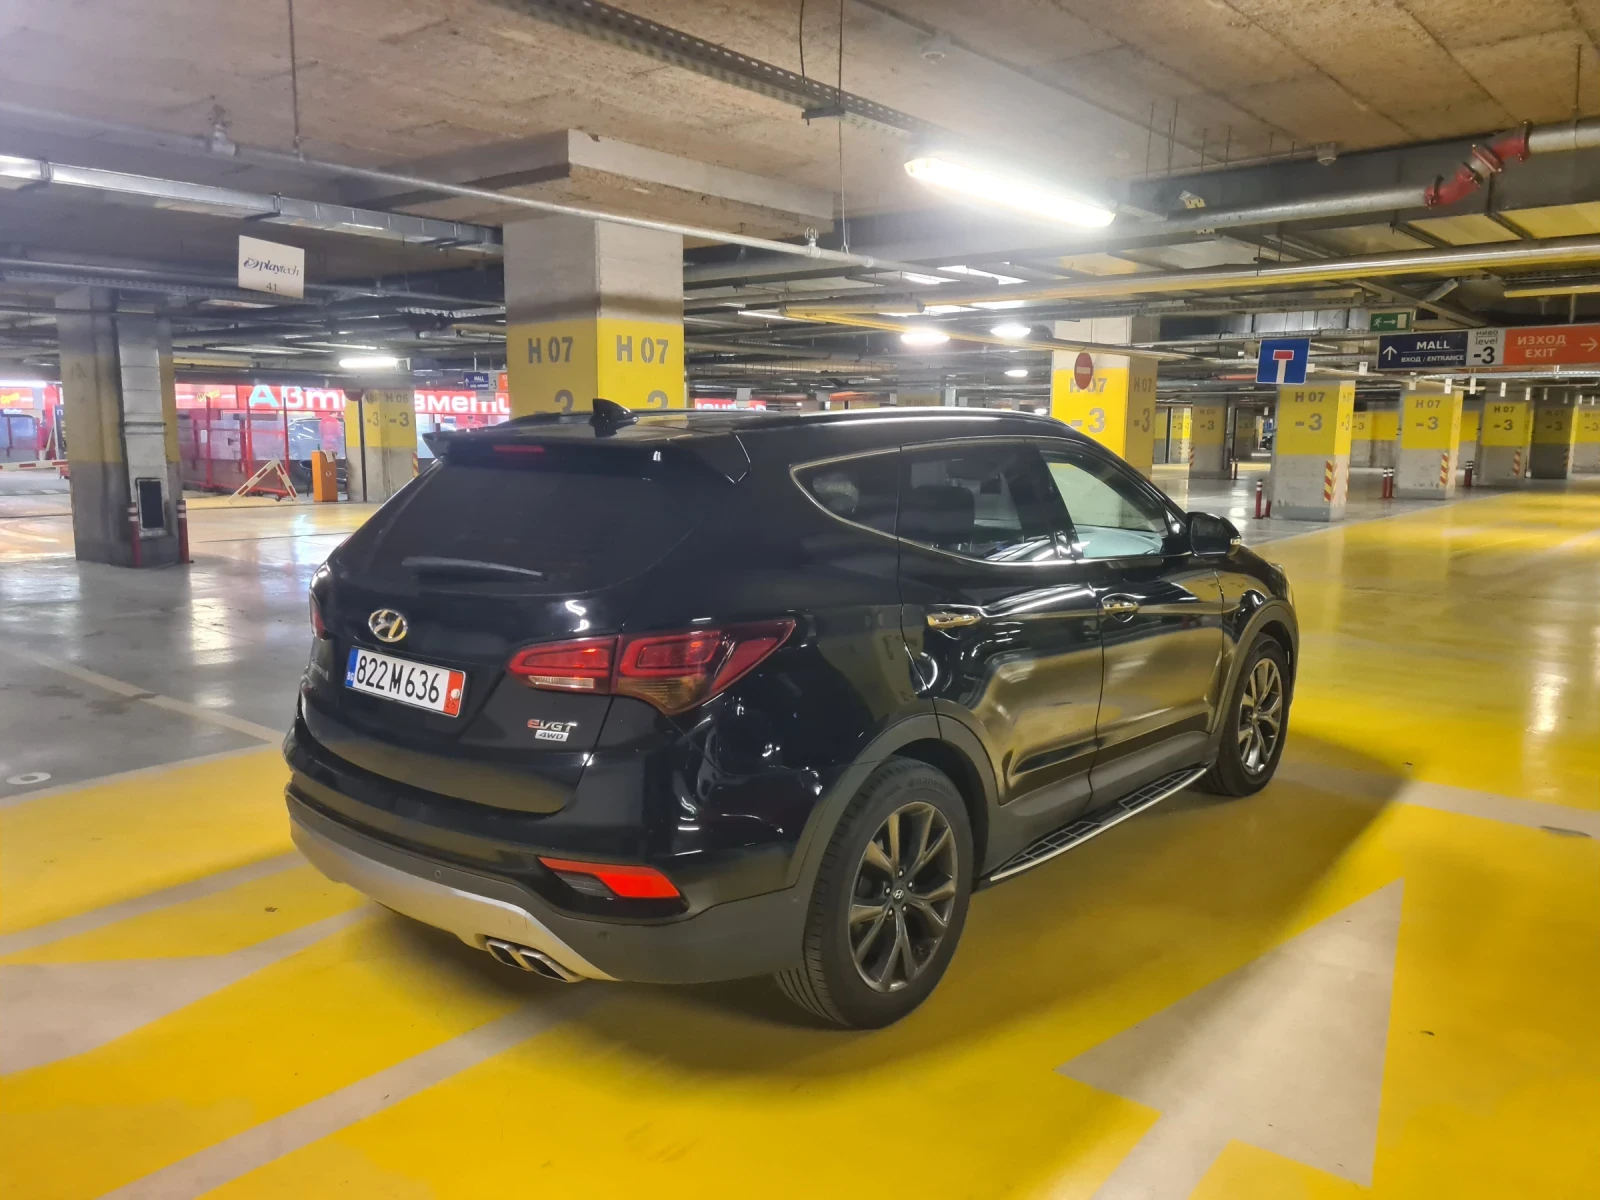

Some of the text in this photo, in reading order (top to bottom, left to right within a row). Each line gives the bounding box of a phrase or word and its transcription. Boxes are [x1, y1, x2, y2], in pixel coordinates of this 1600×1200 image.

[259, 260, 299, 276] playtech
[266, 282, 277, 291] 41
[1416, 340, 1450, 350] MALL
[1475, 337, 1498, 345] level
[1517, 335, 1566, 346] ИЗХОД
[528, 336, 574, 364] H 07
[616, 335, 669, 364] H 07
[1473, 346, 1495, 364] -3
[1525, 348, 1557, 358] EXIT
[1426, 354, 1464, 362] ENTRANCE
[1294, 391, 1325, 402] H 07
[1415, 400, 1442, 408] H 07
[1503, 405, 1515, 413] 07
[388, 411, 410, 427] -3
[1070, 407, 1105, 433] -3
[1294, 413, 1323, 431] -3
[1415, 416, 1439, 430] -3
[1493, 419, 1513, 431] -3
[538, 731, 564, 740] 4WD
